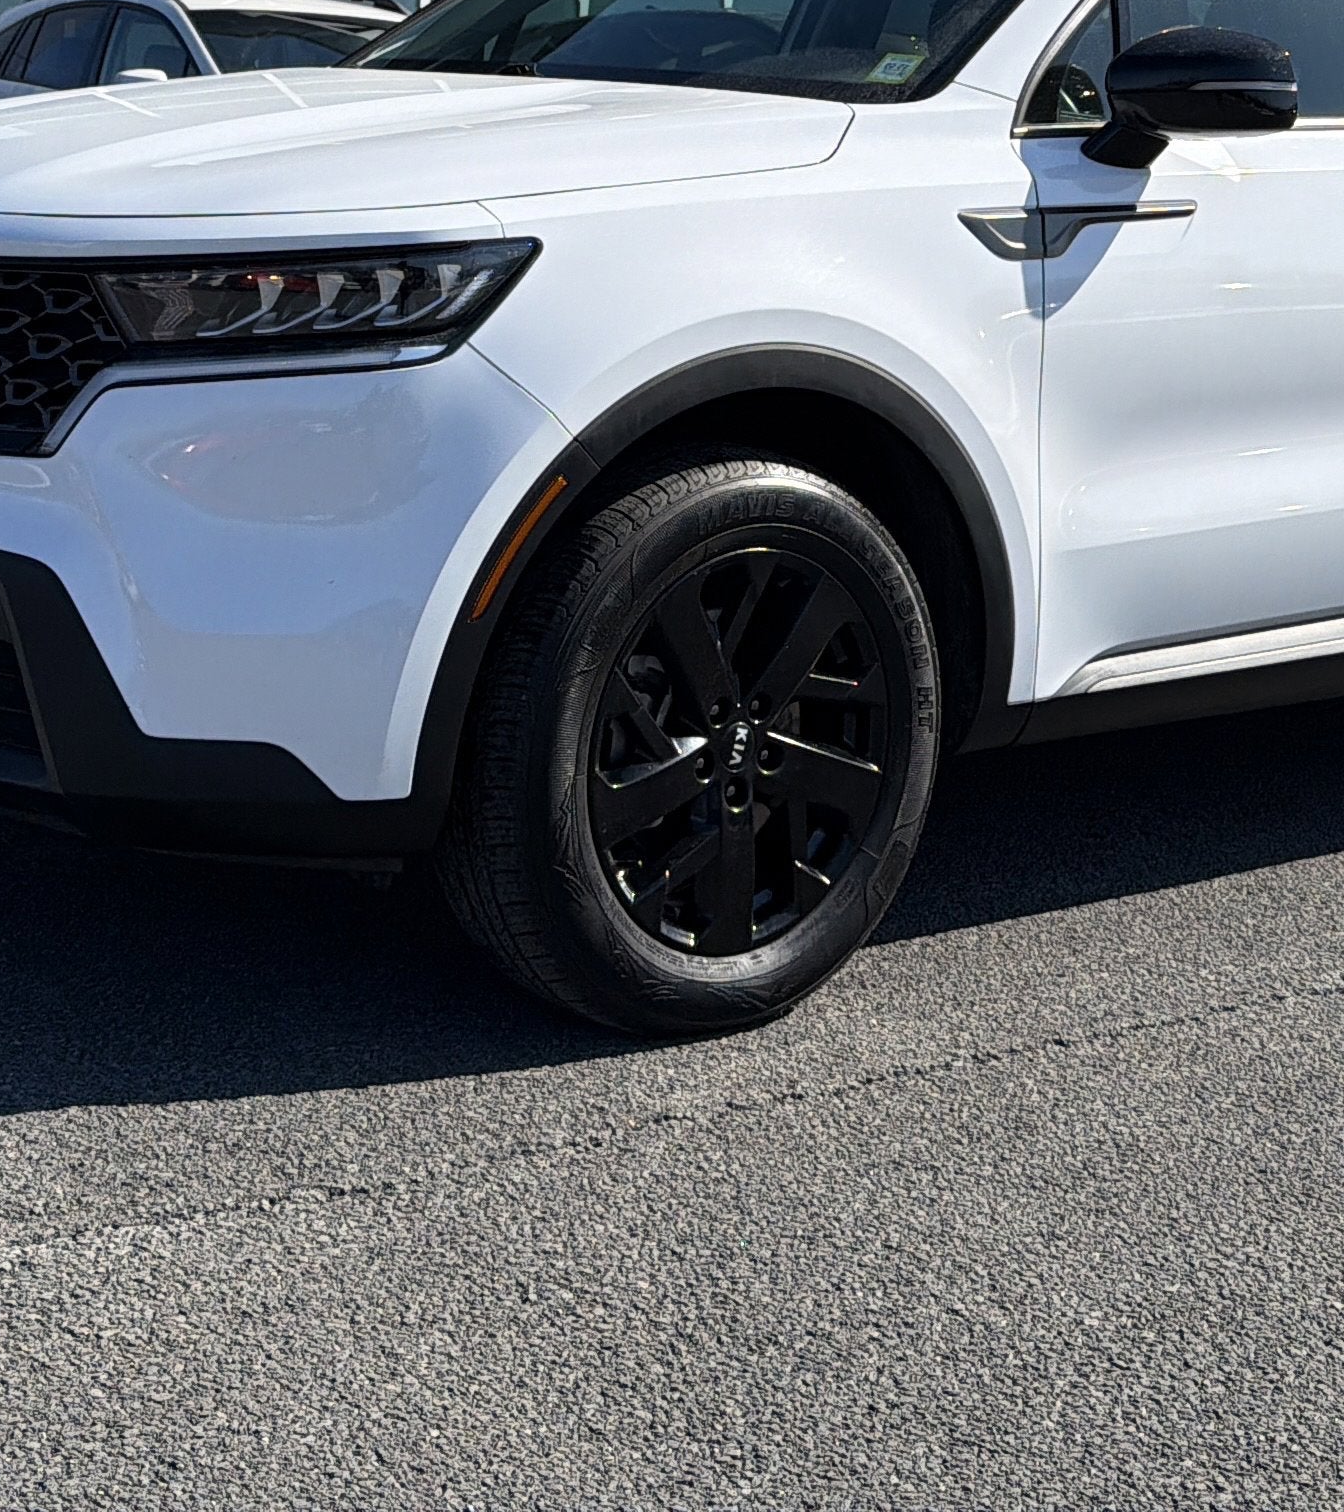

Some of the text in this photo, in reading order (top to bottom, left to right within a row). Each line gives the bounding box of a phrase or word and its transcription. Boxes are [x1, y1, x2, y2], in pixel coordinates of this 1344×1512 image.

[698, 492, 795, 535] MAVIS
[858, 539, 930, 670] SEASON
[729, 727, 749, 765] KIA
